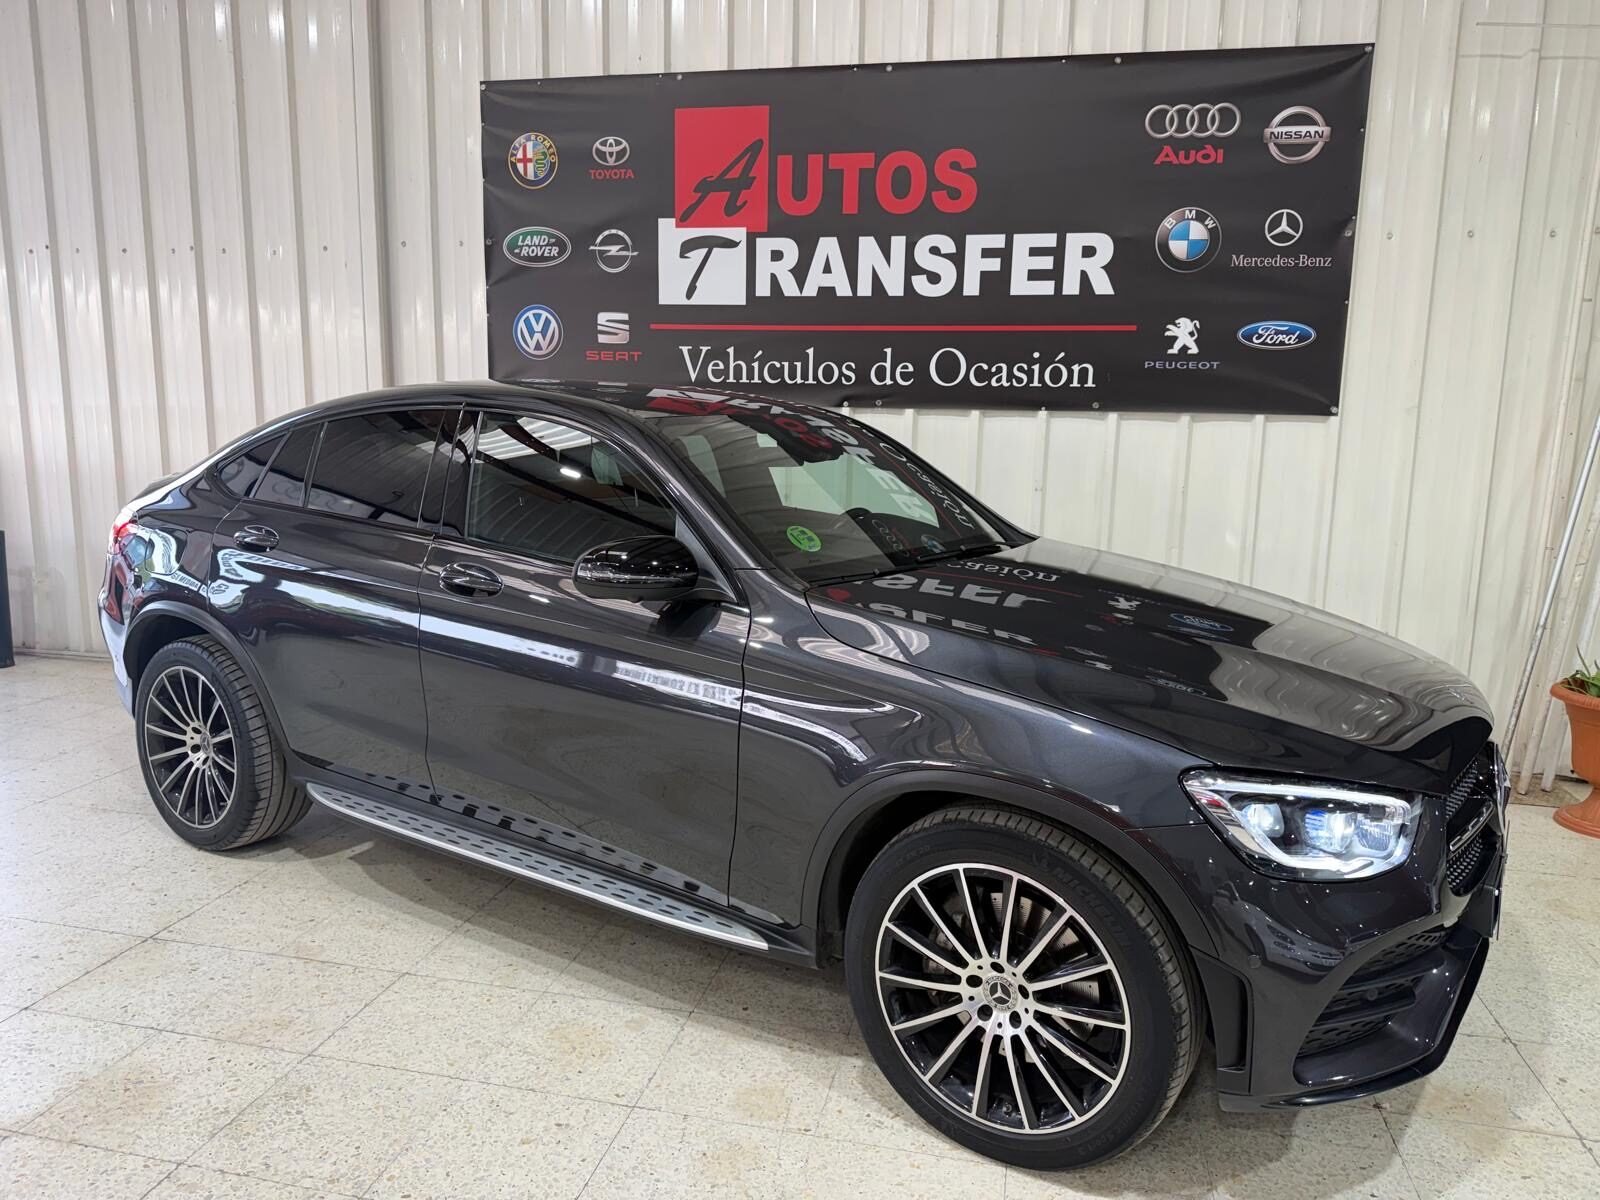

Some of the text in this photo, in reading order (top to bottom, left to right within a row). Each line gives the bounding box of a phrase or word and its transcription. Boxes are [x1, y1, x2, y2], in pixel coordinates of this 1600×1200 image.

[1269, 130, 1325, 140] NISSAN
[530, 134, 556, 163] ROMEO
[1153, 144, 1225, 165] Audi
[588, 169, 635, 179] TOYOTA
[679, 138, 978, 222] AUTOS
[1163, 209, 1217, 230] BMW
[517, 235, 549, 246] LAND
[520, 246, 560, 257] ROVER
[679, 232, 1115, 301] TRANSFER
[1230, 253, 1332, 268] Mercedes-Benz
[1252, 325, 1300, 345] Ford
[586, 351, 643, 362] SEAT
[679, 345, 1096, 388] Vehículos de Ocasión
[1144, 361, 1221, 370] PEUGEOT
